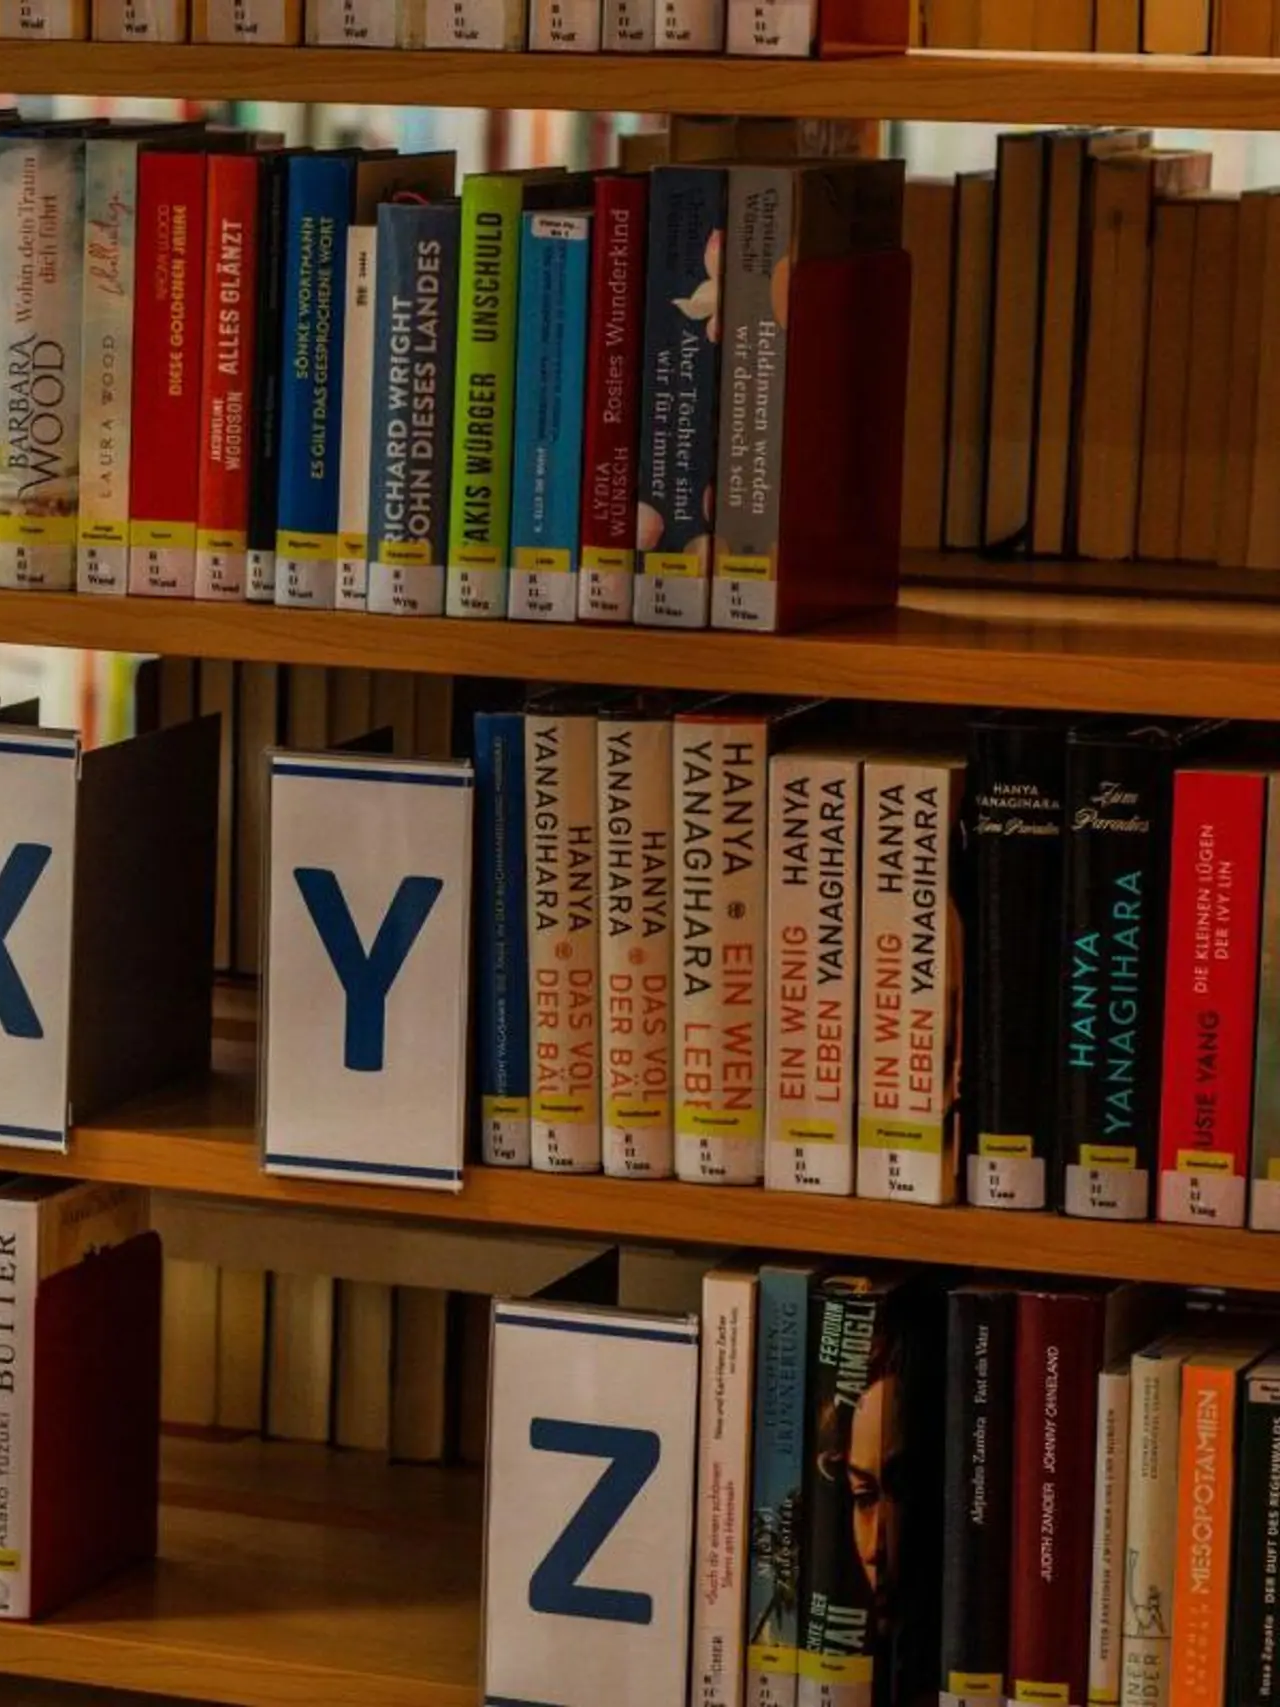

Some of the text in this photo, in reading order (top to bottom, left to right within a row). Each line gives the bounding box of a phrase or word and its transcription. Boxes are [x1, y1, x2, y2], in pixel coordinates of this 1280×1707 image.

[16, 157, 37, 219] Traum
[319, 216, 334, 264] WORT
[16, 265, 37, 325] Wohin
[38, 245, 58, 284] dich
[217, 218, 242, 375] ALLES GLÄNZT
[294, 217, 314, 380] SÖNKE WORTMANN
[414, 240, 440, 353] LANDES
[603, 208, 630, 424] Rosies Wunderkind
[7, 333, 37, 468] BARBARA
[99, 334, 115, 498] LAURA WOOD
[313, 386, 327, 420] DAS
[388, 295, 413, 410] WRIGHT
[411, 361, 436, 460] DIESES
[462, 212, 503, 545] AKIS WÜRGER UNSCHULD
[729, 325, 752, 508] wir dennoch sein
[17, 340, 65, 500] WOOD
[225, 391, 243, 471] WOODSON
[310, 460, 324, 479] ES
[652, 350, 675, 499] wir für immer
[674, 328, 700, 521] Aber Töchter sind
[751, 320, 777, 515] Heldinnen werden
[594, 461, 611, 521] LYDIA
[609, 446, 630, 538] WÜNSCH
[534, 726, 559, 932] YANAGIHARA
[567, 826, 593, 933] HANYA
[608, 731, 633, 938] YANAGIHARA
[642, 831, 667, 939] HANYA
[683, 740, 713, 997] YANAGIHARA
[782, 776, 810, 886] HANYA
[818, 778, 846, 986] YANAGIHARA
[878, 784, 905, 894] HANYA
[912, 787, 938, 994] YANAGIHARA
[292, 867, 445, 1073] Y
[721, 742, 753, 1111] HANYA EIN WEN
[1192, 823, 1215, 994] DIE KLEINEN LÜGEN
[1212, 860, 1233, 959] DER IVY LIN
[536, 968, 559, 1029] DER
[568, 968, 593, 1097] DAS VOL
[608, 973, 633, 1035] DER
[642, 974, 667, 1104] DAS VOL
[780, 925, 808, 1101] EIN WENIG
[815, 999, 842, 1103] LEBEN
[873, 932, 902, 1110] EIN WENIG
[909, 1008, 935, 1114] LEBEN
[1068, 932, 1101, 1068] HANYA
[1103, 869, 1143, 1134] YANAGIHARA
[1193, 1009, 1220, 1150] USIE YANG
[974, 1380, 988, 1405] Fast
[1044, 1345, 1059, 1418] OHNELAND
[528, 1416, 661, 1626] Z
[1041, 1482, 1055, 1535] ZANDER
[1189, 1388, 1218, 1593] MESOPOTAMIEN
[1263, 1576, 1276, 1604] DER
[1265, 1539, 1278, 1574] DUFT
[824, 1604, 868, 1653] AU
